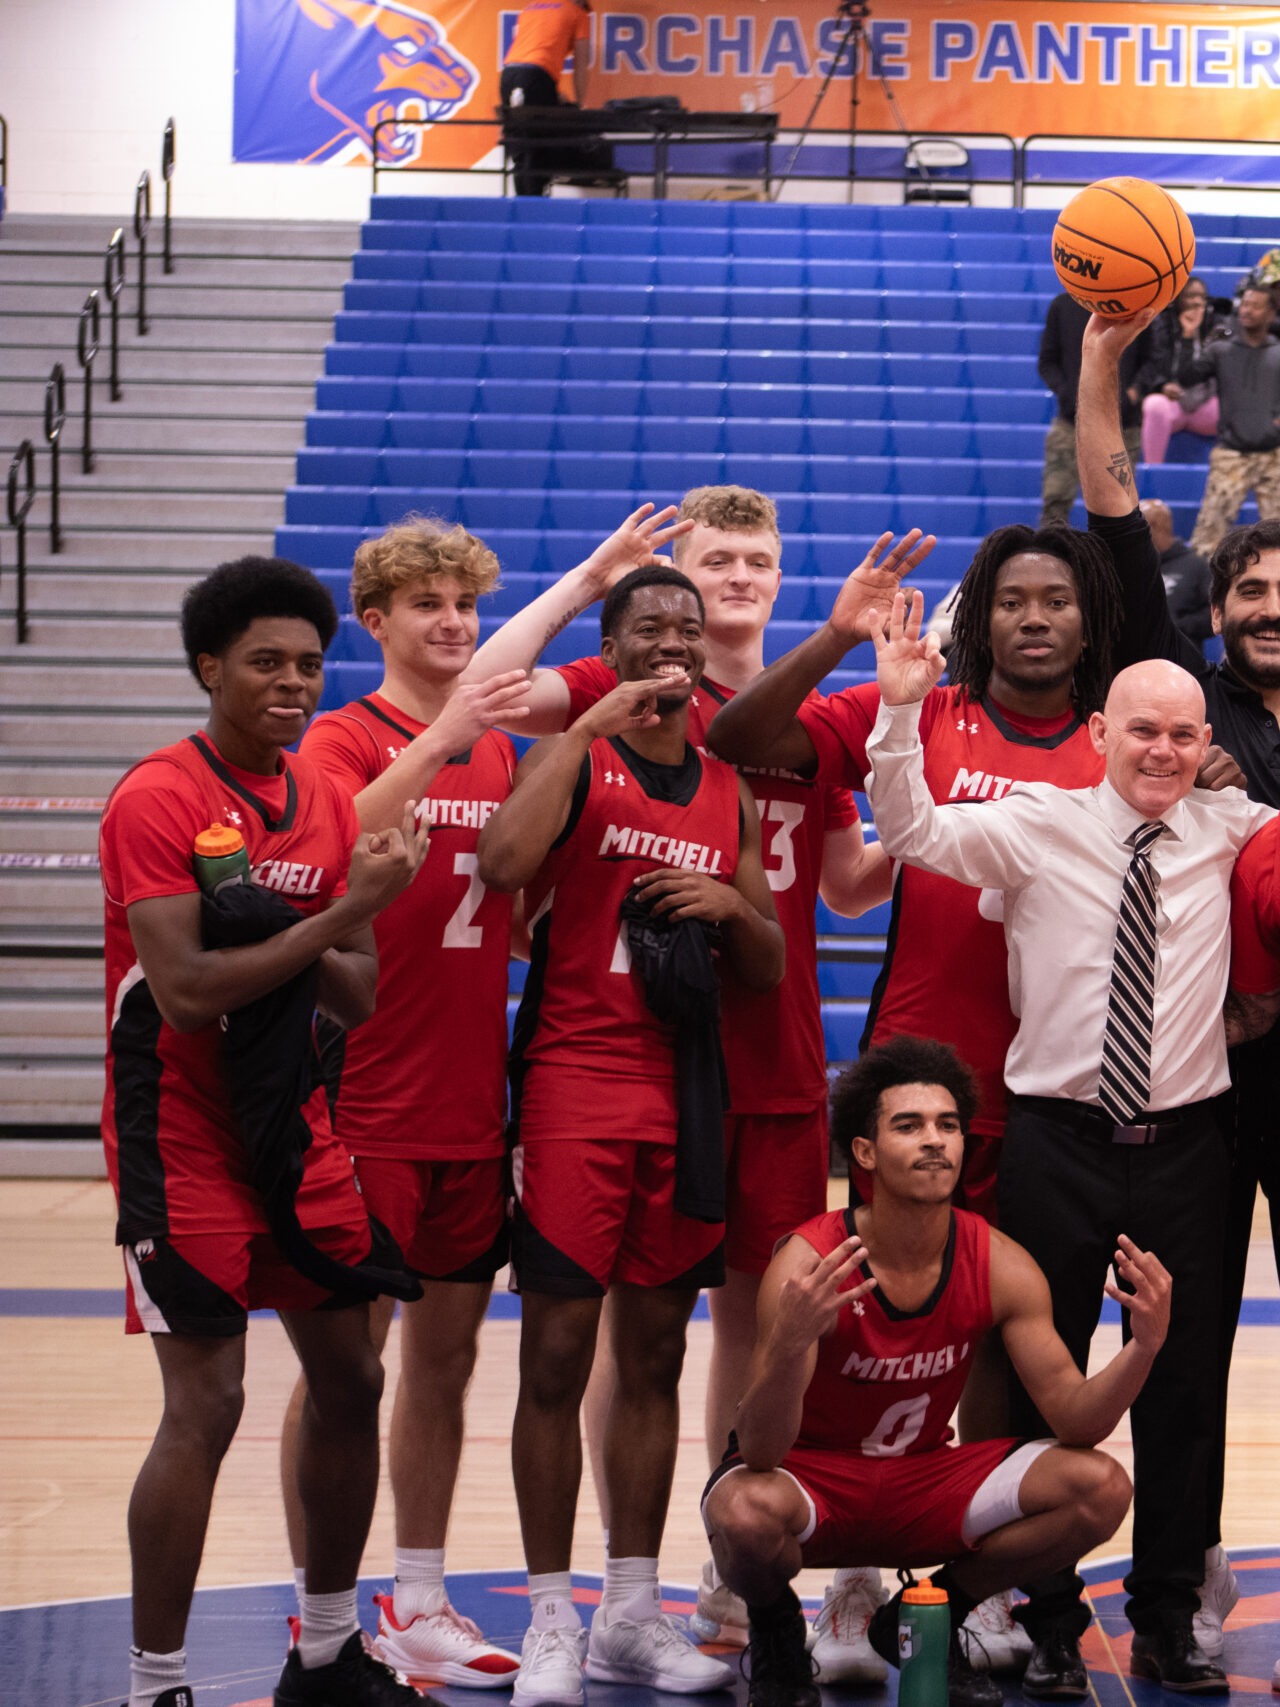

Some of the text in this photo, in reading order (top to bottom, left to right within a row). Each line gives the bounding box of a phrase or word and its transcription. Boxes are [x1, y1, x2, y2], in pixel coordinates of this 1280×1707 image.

[1055, 242, 1102, 281] NCAA
[414, 797, 500, 828] MITCHE
[598, 824, 722, 874] MITCHELL
[250, 860, 324, 894] CHELL
[442, 853, 486, 948] 2
[861, 1392, 930, 1457] 0
